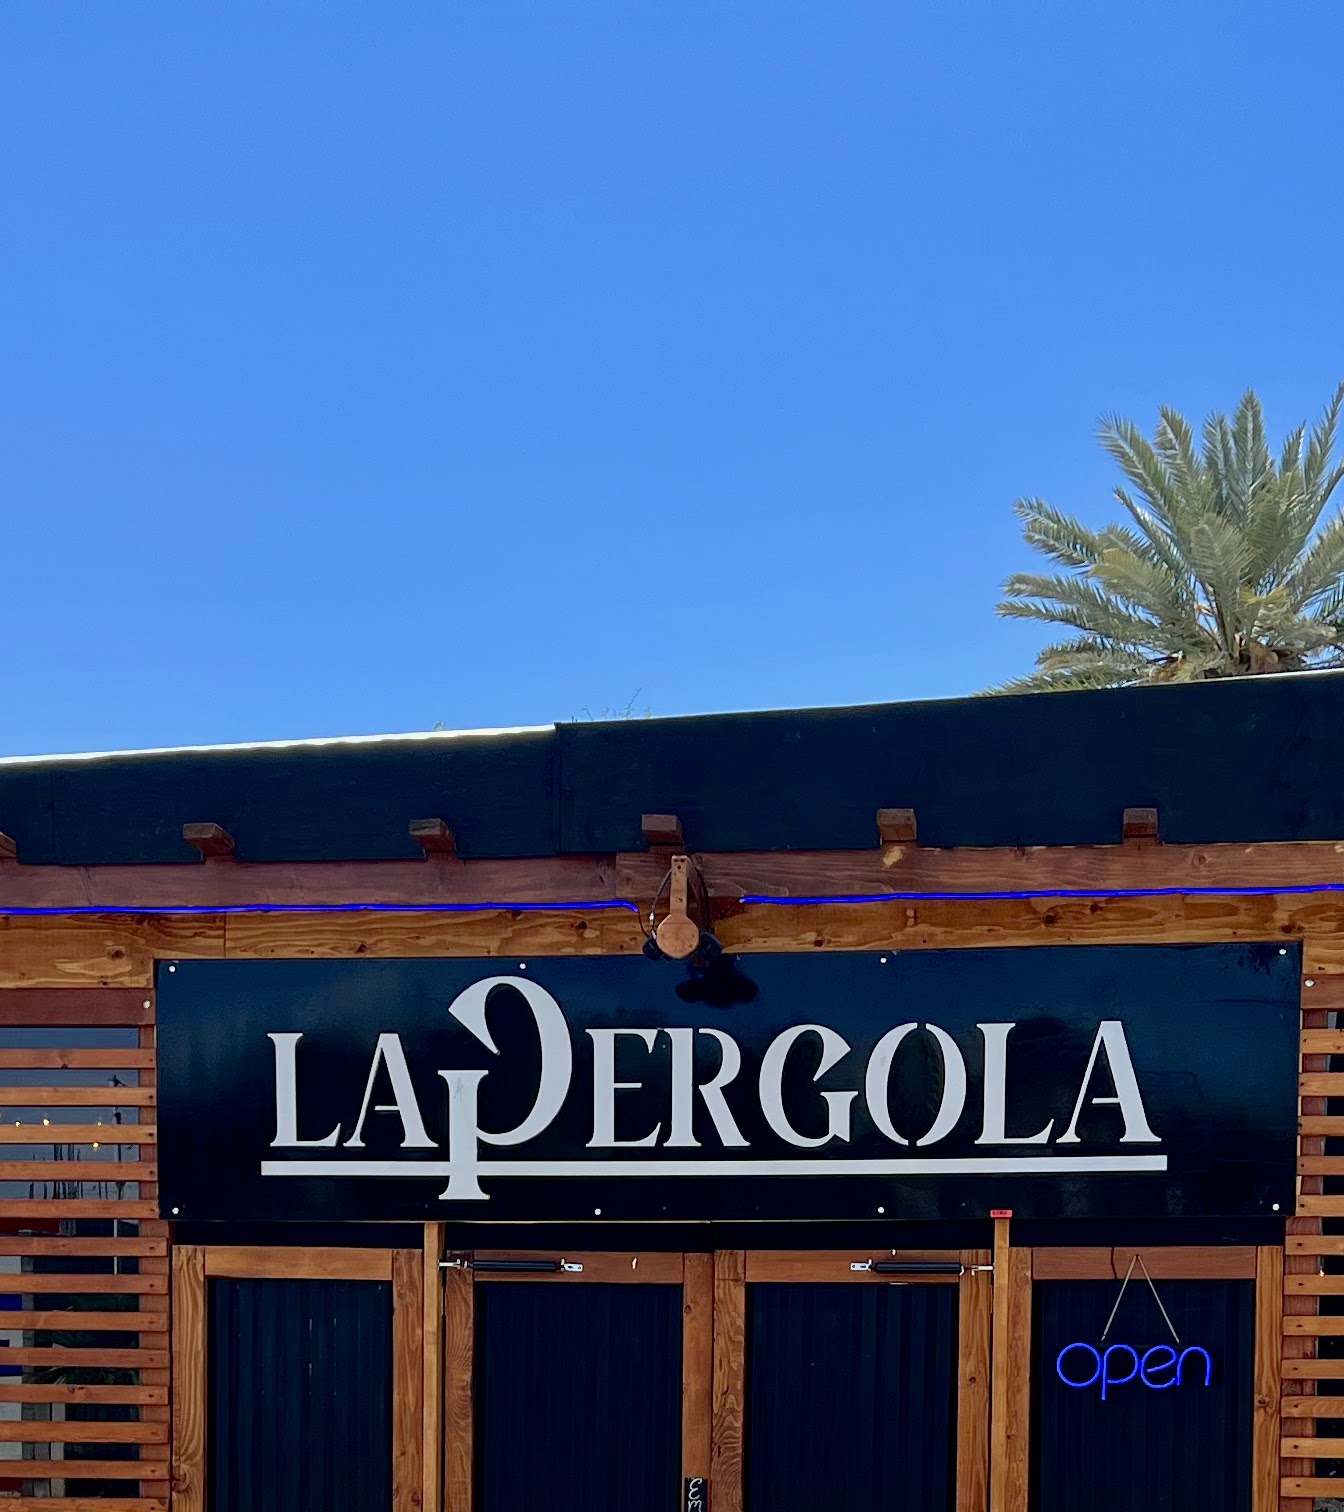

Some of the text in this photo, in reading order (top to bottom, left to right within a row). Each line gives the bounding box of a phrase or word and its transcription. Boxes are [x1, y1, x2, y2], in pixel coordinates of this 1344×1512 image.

[267, 976, 1162, 1200] LA PERGOLA
[1056, 1342, 1212, 1401] open
